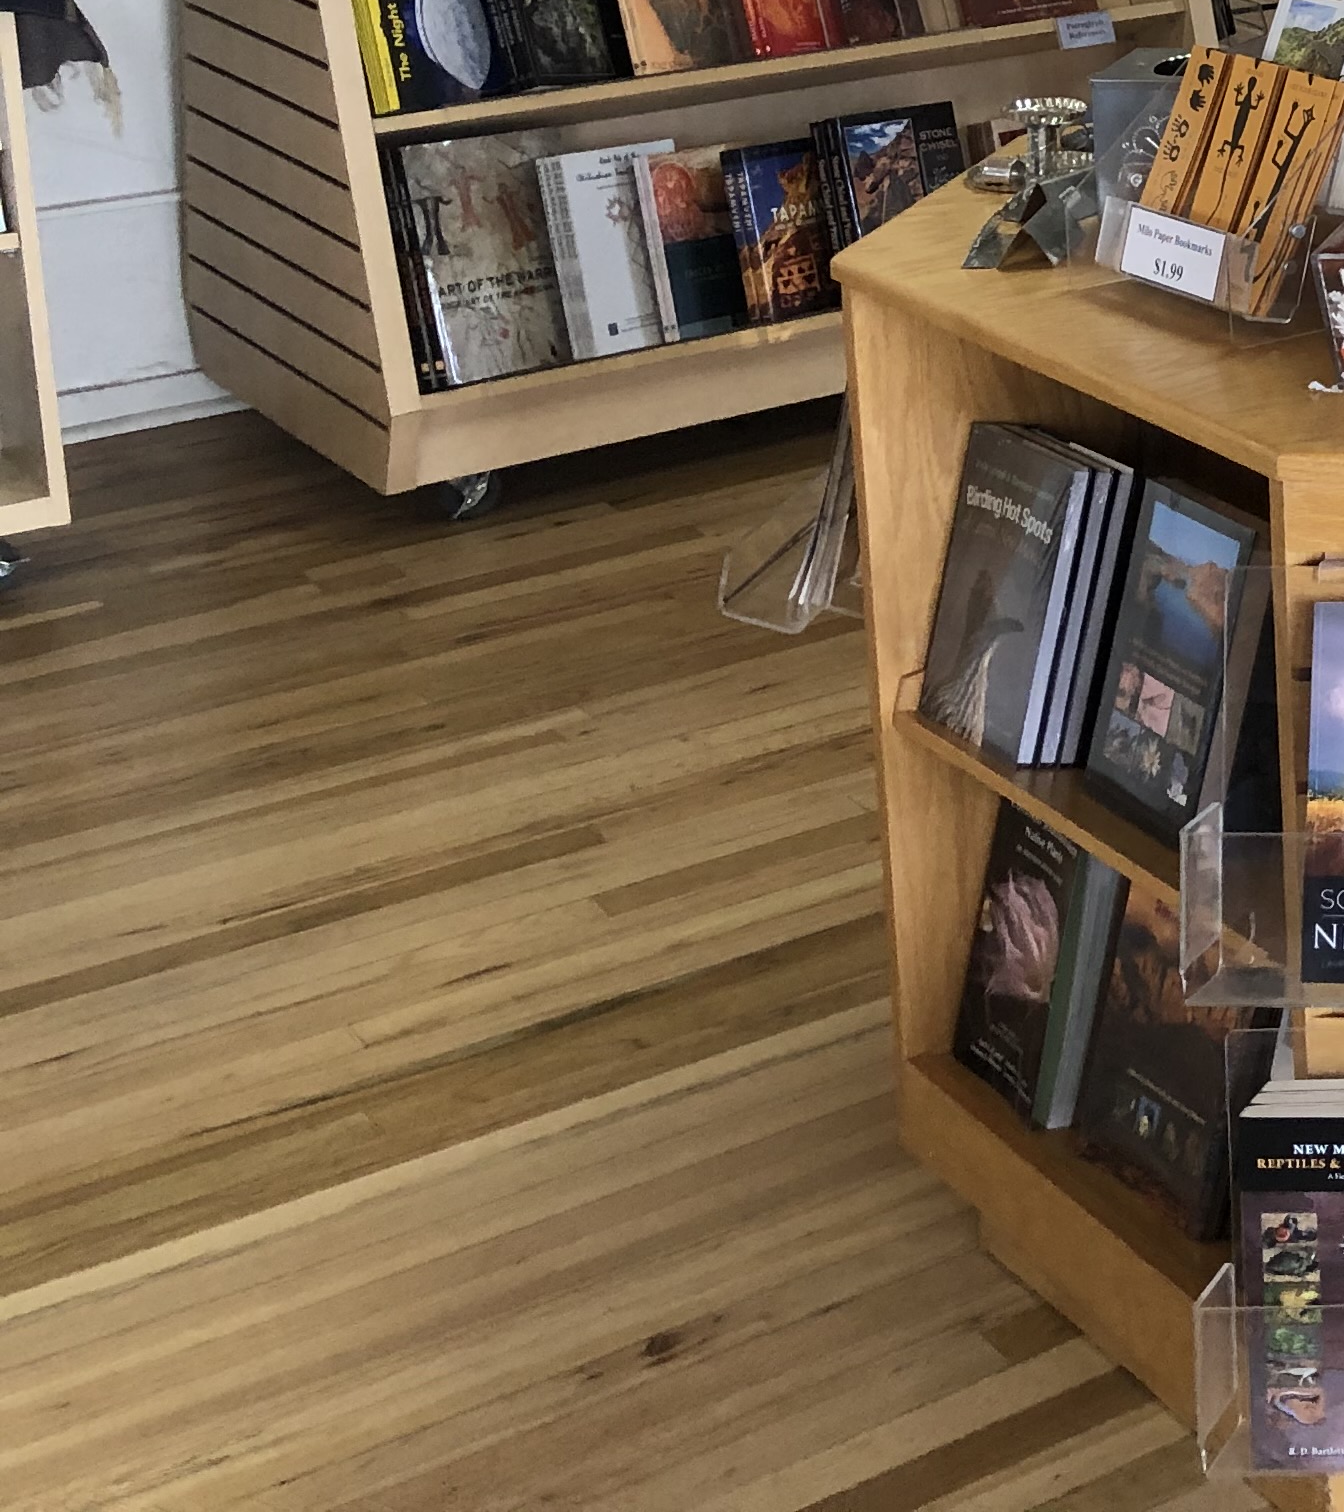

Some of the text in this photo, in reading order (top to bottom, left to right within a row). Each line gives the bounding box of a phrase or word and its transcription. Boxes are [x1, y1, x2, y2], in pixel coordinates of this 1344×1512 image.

[391, 1, 407, 50] Night
[395, 56, 412, 82] The
[1153, 228, 1213, 256] Paper Bookmarks
[1153, 257, 1184, 282] $1.99
[966, 484, 1054, 544] Birding Hot Spots
[1293, 1143, 1329, 1156] NEW
[1256, 1158, 1327, 1170] REPTILES
[1329, 1158, 1340, 1170] &
[1300, 1446, 1344, 1457] D. Bartlett
